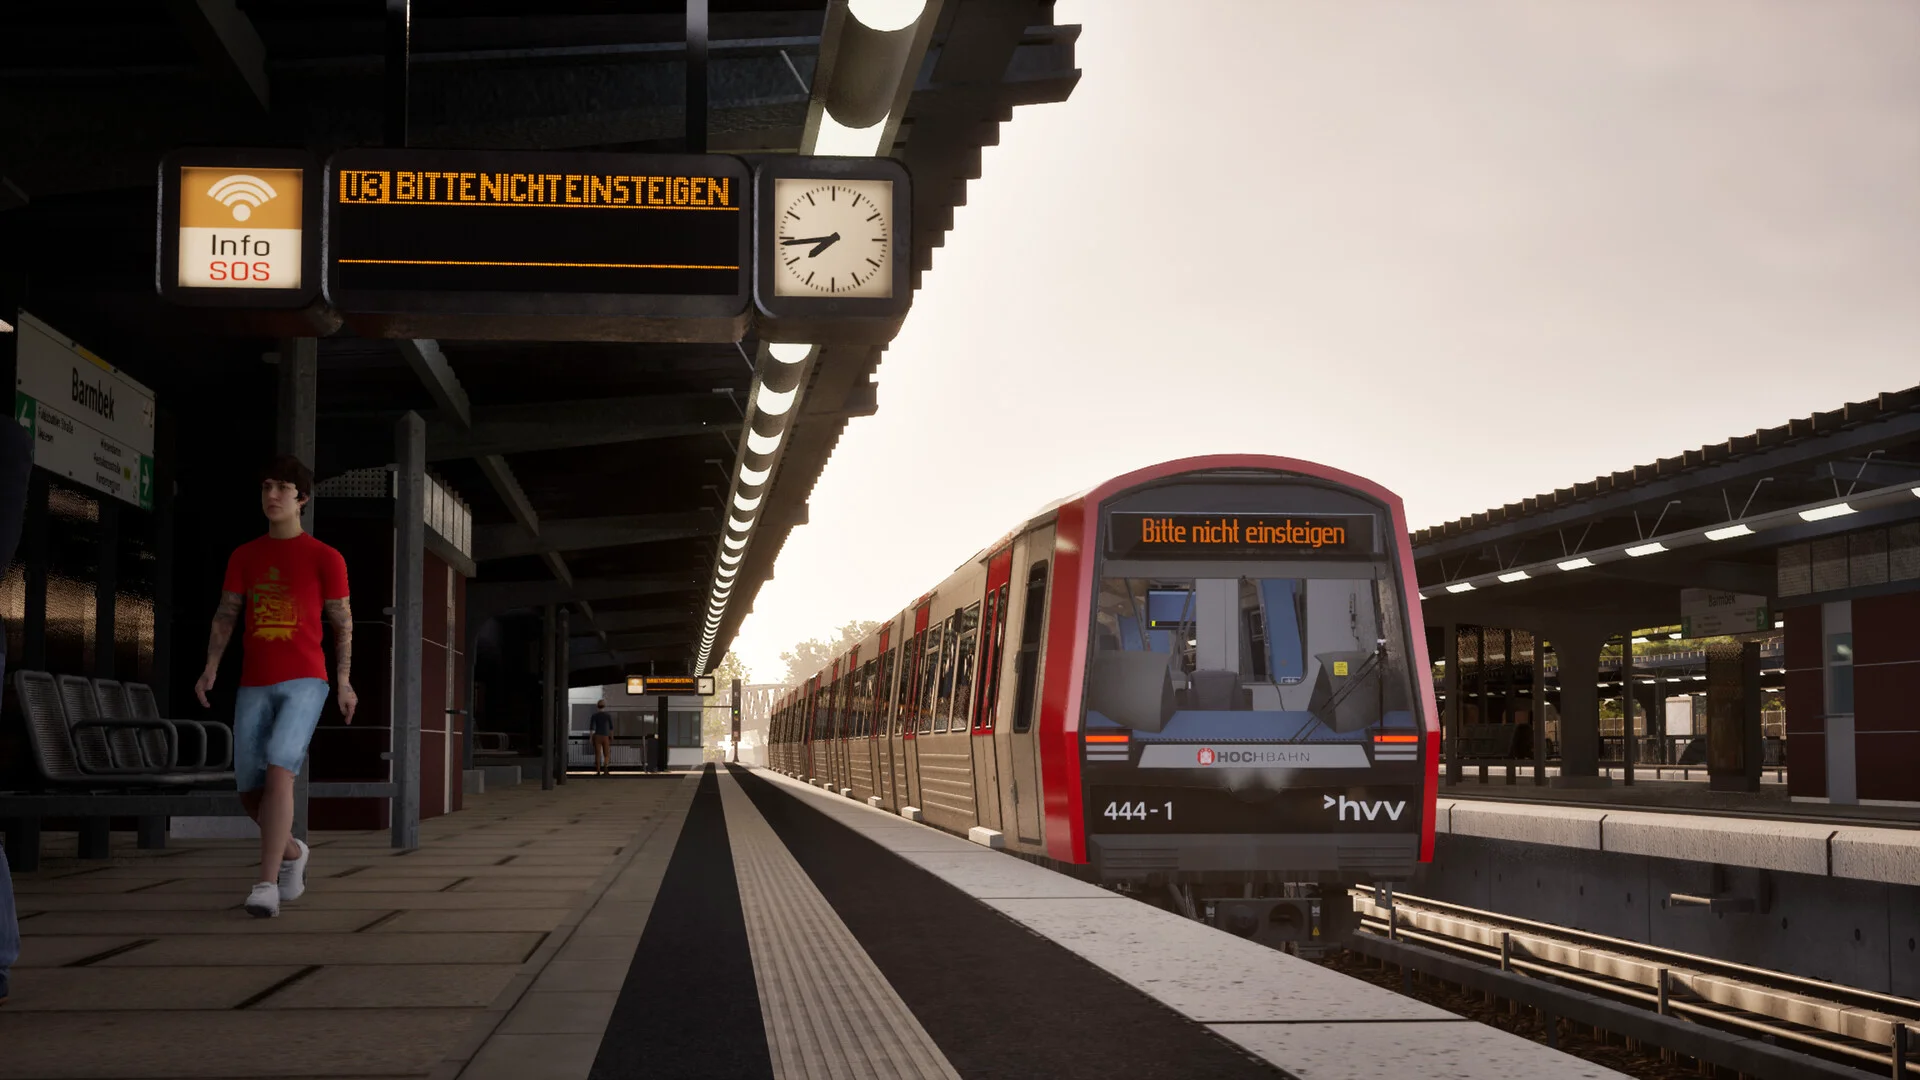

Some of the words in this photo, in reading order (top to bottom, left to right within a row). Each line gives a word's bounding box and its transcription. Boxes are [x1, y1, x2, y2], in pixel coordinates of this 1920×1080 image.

[342, 171, 387, 202] U3
[396, 171, 477, 201] BITTE
[479, 172, 563, 202] NICHT
[565, 174, 730, 206] EINSTEIGEN
[212, 234, 270, 256] Info
[209, 261, 270, 281] SOS
[71, 366, 115, 421] Barmbek
[1142, 518, 1186, 543] Bitte
[1192, 519, 1240, 543] nicht
[1245, 519, 1346, 548] einsteigen
[1217, 751, 1311, 763] HOCHBAHN
